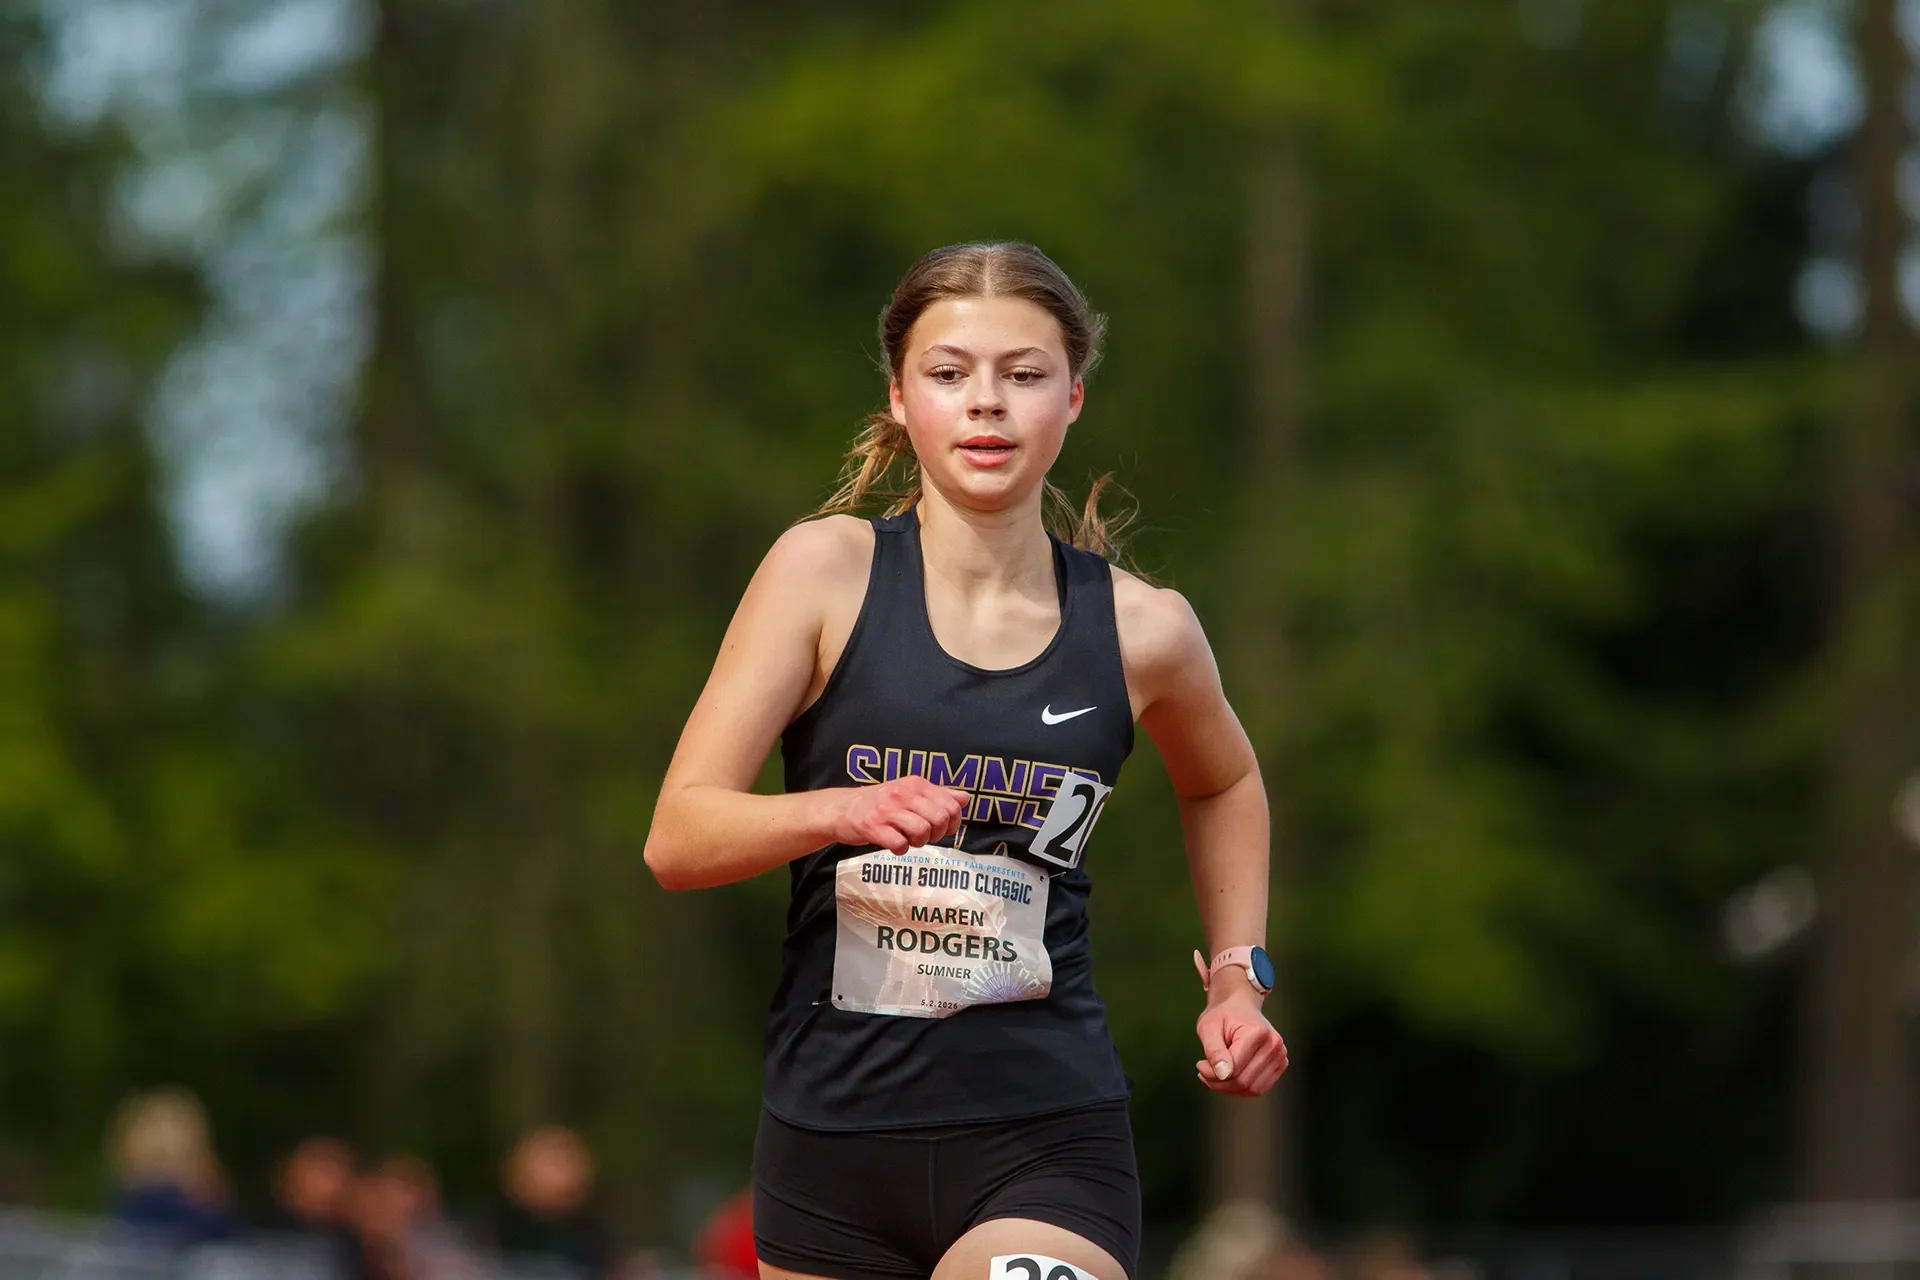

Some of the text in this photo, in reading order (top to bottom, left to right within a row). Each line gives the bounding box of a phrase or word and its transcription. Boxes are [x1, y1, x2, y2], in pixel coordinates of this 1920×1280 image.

[873, 854, 1026, 880] WASHINGTON STATE FAIR PRESENTS
[861, 862, 1033, 905] SOUTH SOUND CLASSIC
[911, 905, 984, 927] MAREN
[877, 925, 1018, 963] RODGERS
[917, 963, 972, 980] SUMNER
[920, 999, 958, 1010] 5.2.2026
